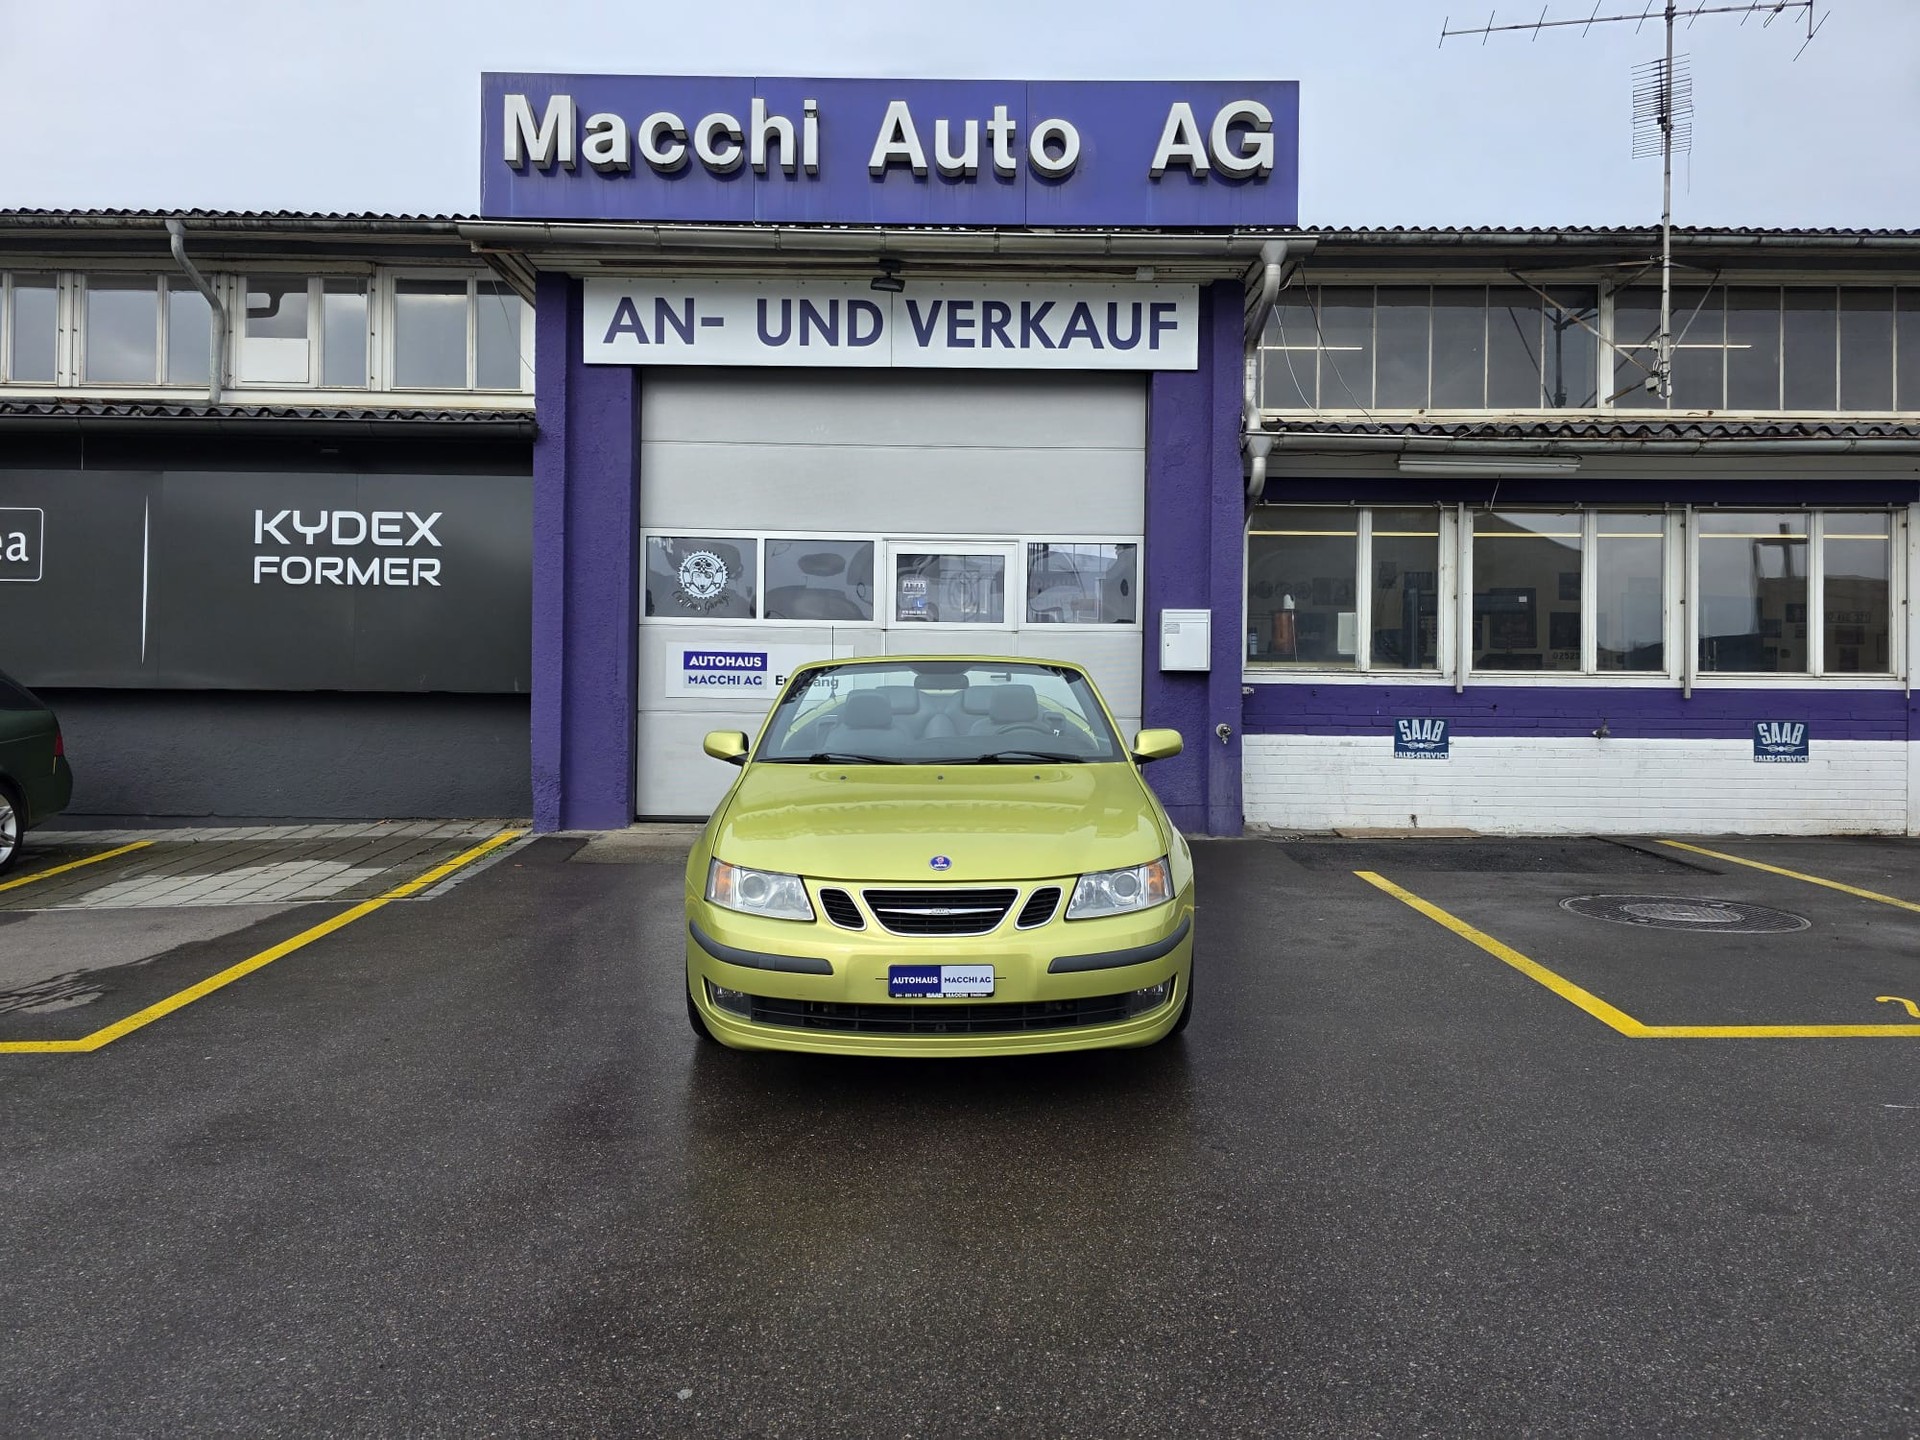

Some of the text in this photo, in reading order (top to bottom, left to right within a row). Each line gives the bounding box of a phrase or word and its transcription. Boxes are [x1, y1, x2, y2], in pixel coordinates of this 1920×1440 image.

[504, 94, 1275, 178] Macchi Auto AG
[602, 296, 1179, 350] AN- UND VERKAUF
[254, 509, 443, 547] KYDEX
[253, 556, 442, 586] FORMER
[689, 655, 763, 668] AUTOHAUS
[688, 675, 763, 685] MACCHI AG
[1398, 719, 1445, 741] SAAB
[1757, 722, 1805, 745] SAAB
[892, 976, 992, 984] AUTOHAUS MACCHI AG
